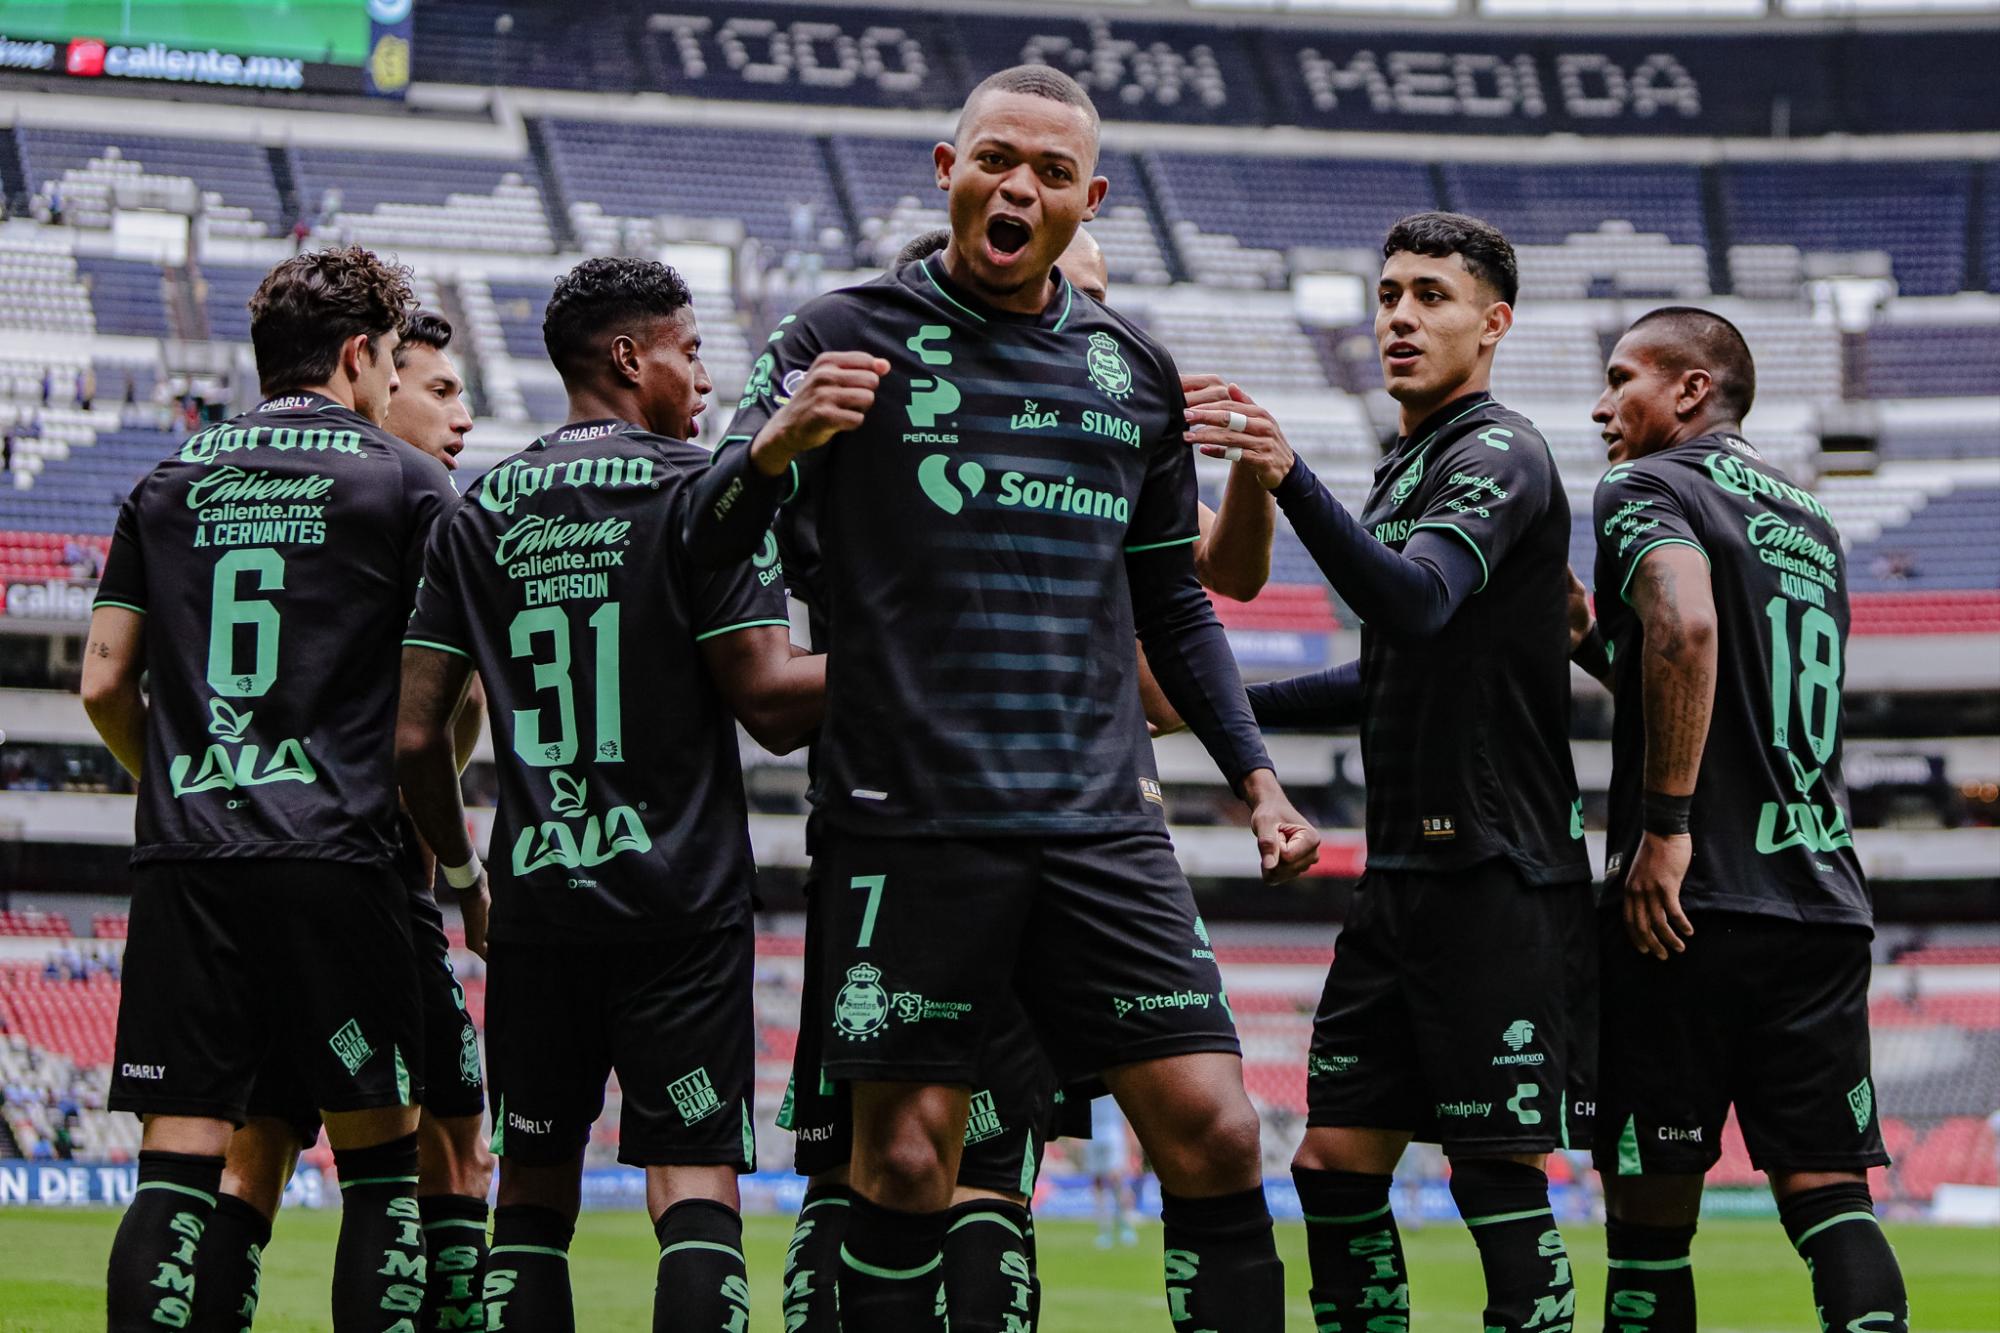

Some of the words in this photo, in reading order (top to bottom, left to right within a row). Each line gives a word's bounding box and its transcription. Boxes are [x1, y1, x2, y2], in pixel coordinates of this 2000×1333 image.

[105, 43, 305, 90] caliente.mx
[647, 14, 928, 92] TODO
[1299, 48, 1701, 118] MEDIDA
[260, 396, 313, 412] CHARLY
[1010, 411, 1058, 430] LALA
[180, 423, 362, 465] Corona
[559, 423, 617, 442] CHARLY
[1081, 410, 1140, 449] SIMSA
[186, 465, 335, 509] Caliente
[479, 456, 655, 515] Corona
[996, 471, 1128, 524] Soriana
[1448, 472, 1509, 499] Omnibus
[199, 502, 325, 522] caliente.mx
[193, 526, 211, 547] A.
[214, 520, 326, 546] CERVANTES
[495, 514, 632, 566] Caliente
[1744, 510, 1837, 570] Caliente
[508, 550, 625, 579] caliente.mx
[1759, 548, 1837, 592] caliente.mx
[524, 572, 609, 607] EMERSON
[207, 547, 286, 697] 6
[508, 601, 625, 767] 31
[1766, 596, 1841, 766] 18
[170, 738, 317, 799] LALA
[511, 805, 652, 877] LALA
[850, 873, 887, 948] 7
[923, 1000, 972, 1012] SANATORIO
[1134, 989, 1210, 1011] Totalplay
[332, 1019, 360, 1053] CITY
[341, 1036, 369, 1069] CLUB
[122, 1062, 166, 1081] CHARLY
[670, 1069, 707, 1102] CITY
[677, 1087, 718, 1119] CLUB
[508, 1111, 553, 1135] CHARLY
[38, 1167, 91, 1204] DE
